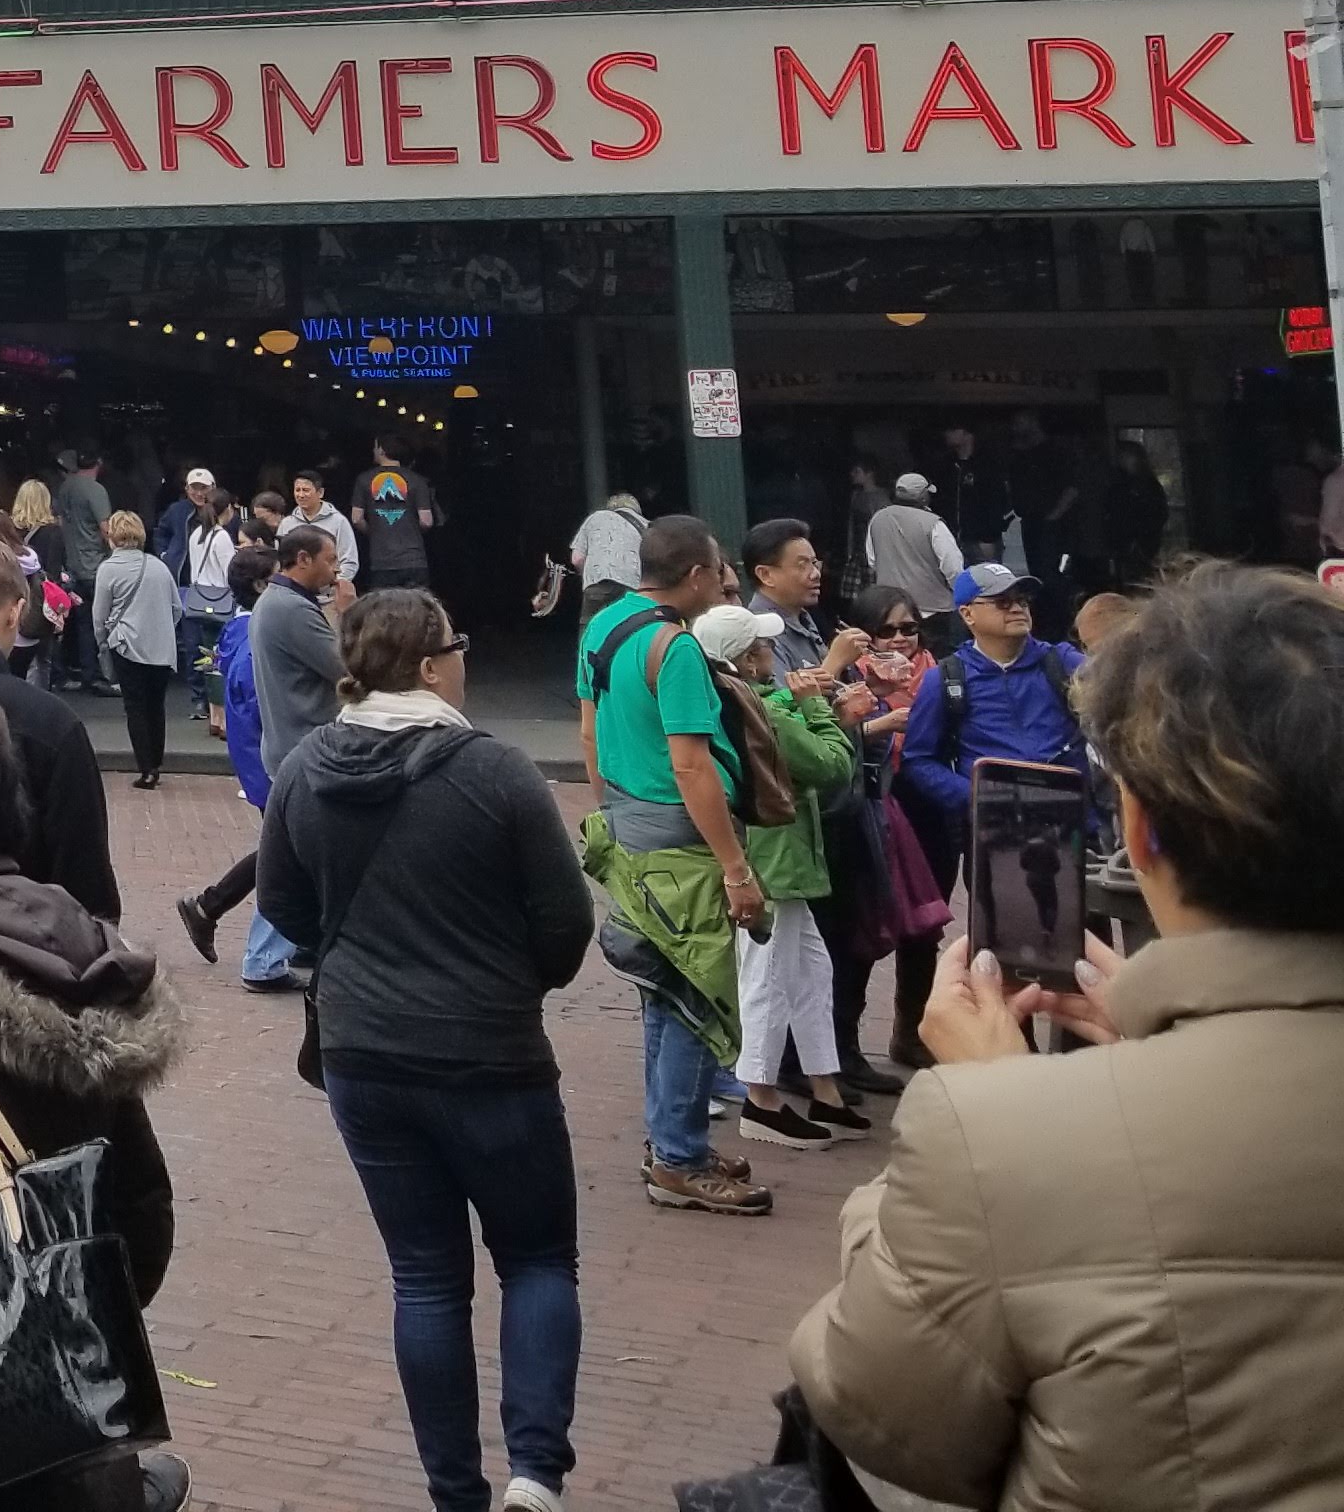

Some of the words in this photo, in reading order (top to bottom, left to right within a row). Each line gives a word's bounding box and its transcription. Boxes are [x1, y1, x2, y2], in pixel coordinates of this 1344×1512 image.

[774, 29, 1316, 156] MARK
[329, 345, 473, 367] VIEWPOINT
[361, 368, 400, 379] PUBLIC
[403, 368, 452, 378] SEATING
